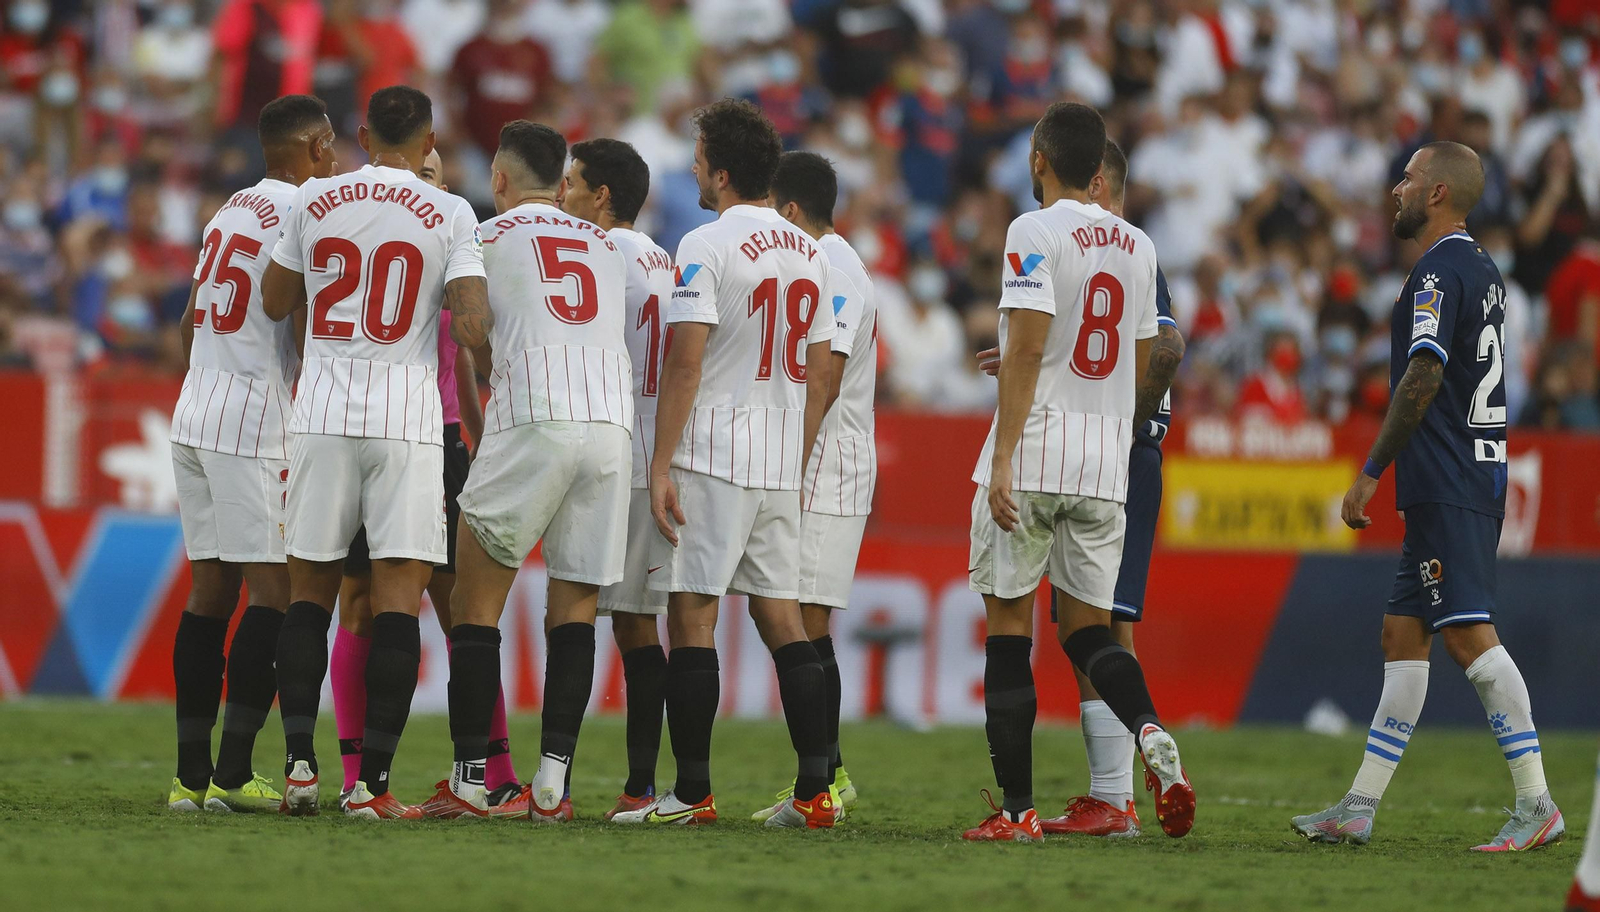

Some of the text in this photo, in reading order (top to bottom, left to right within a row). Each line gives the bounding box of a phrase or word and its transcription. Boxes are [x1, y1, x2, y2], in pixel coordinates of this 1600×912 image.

[306, 182, 444, 230] DIEGO CARLOS
[739, 229, 818, 264] DELANEY
[309, 236, 424, 346] 20
[531, 235, 599, 326] 5
[1004, 279, 1043, 290] Valvoline
[1069, 271, 1125, 381] 8
[748, 277, 820, 384] 18
